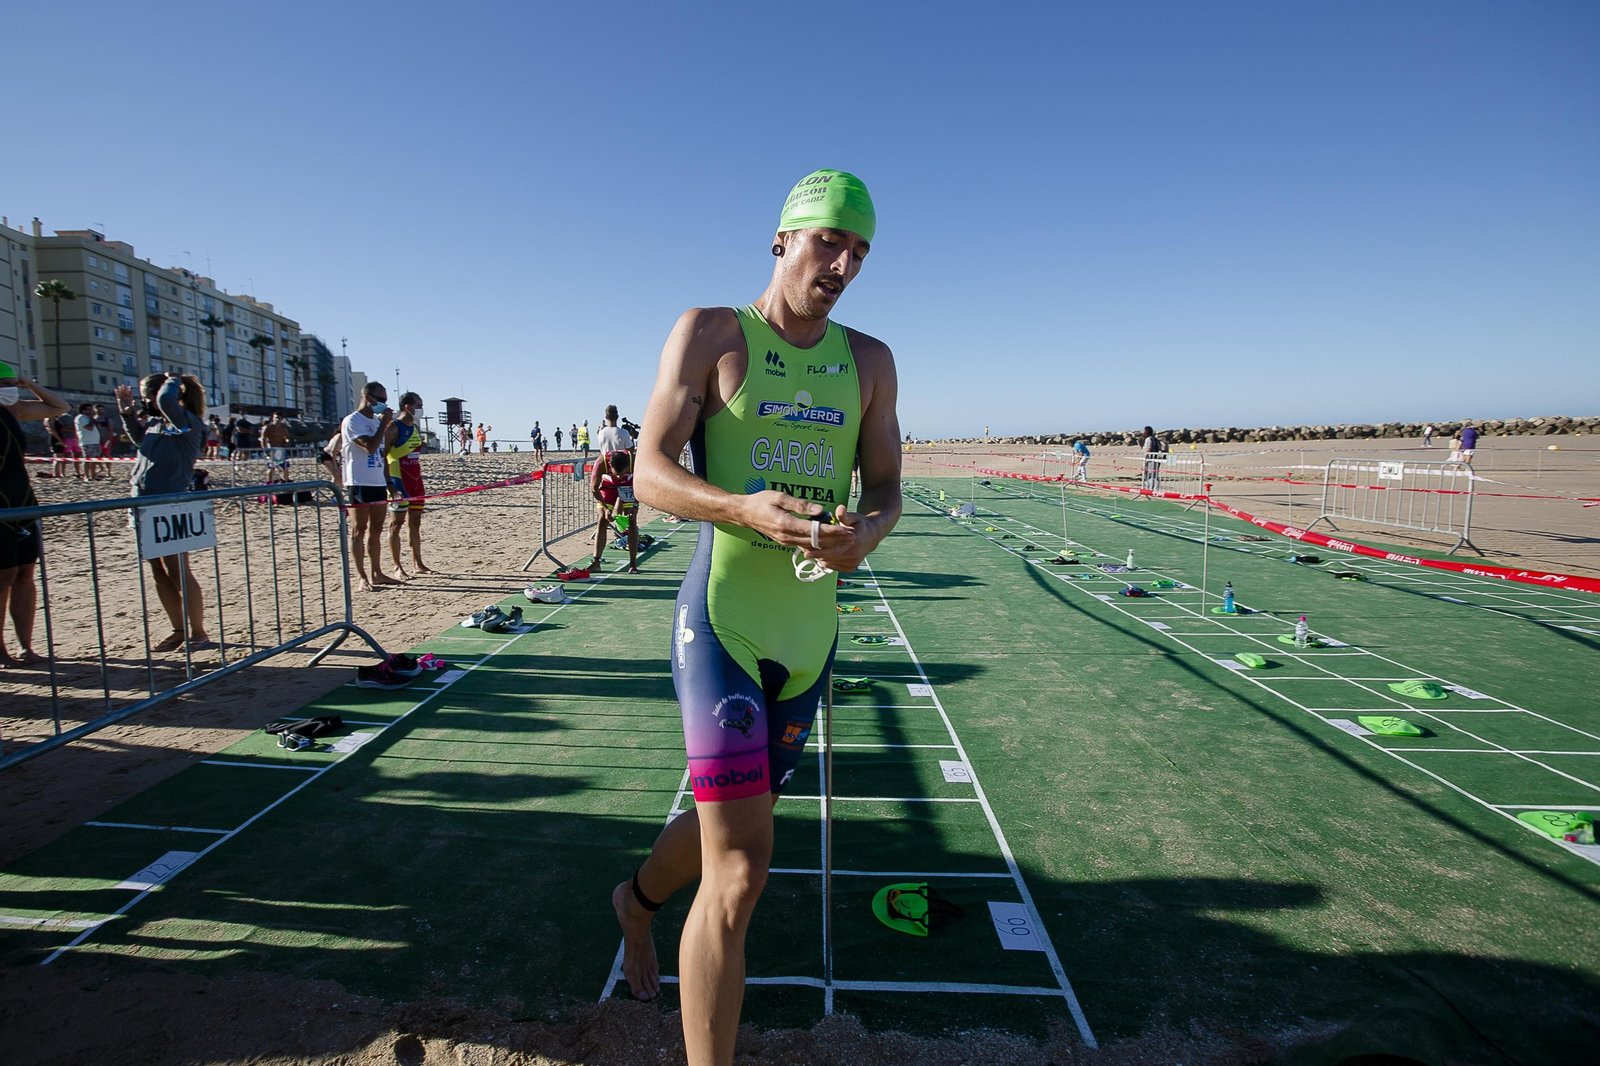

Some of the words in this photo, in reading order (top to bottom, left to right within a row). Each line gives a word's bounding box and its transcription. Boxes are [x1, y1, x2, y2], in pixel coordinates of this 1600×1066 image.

[765, 368, 786, 378] mobel
[763, 404, 798, 417] SIMÓN
[802, 409, 841, 423] VERDE
[790, 422, 812, 430] Sport
[751, 437, 835, 479] GARCÍA
[694, 764, 764, 788] mobel
[137, 863, 180, 879] 22
